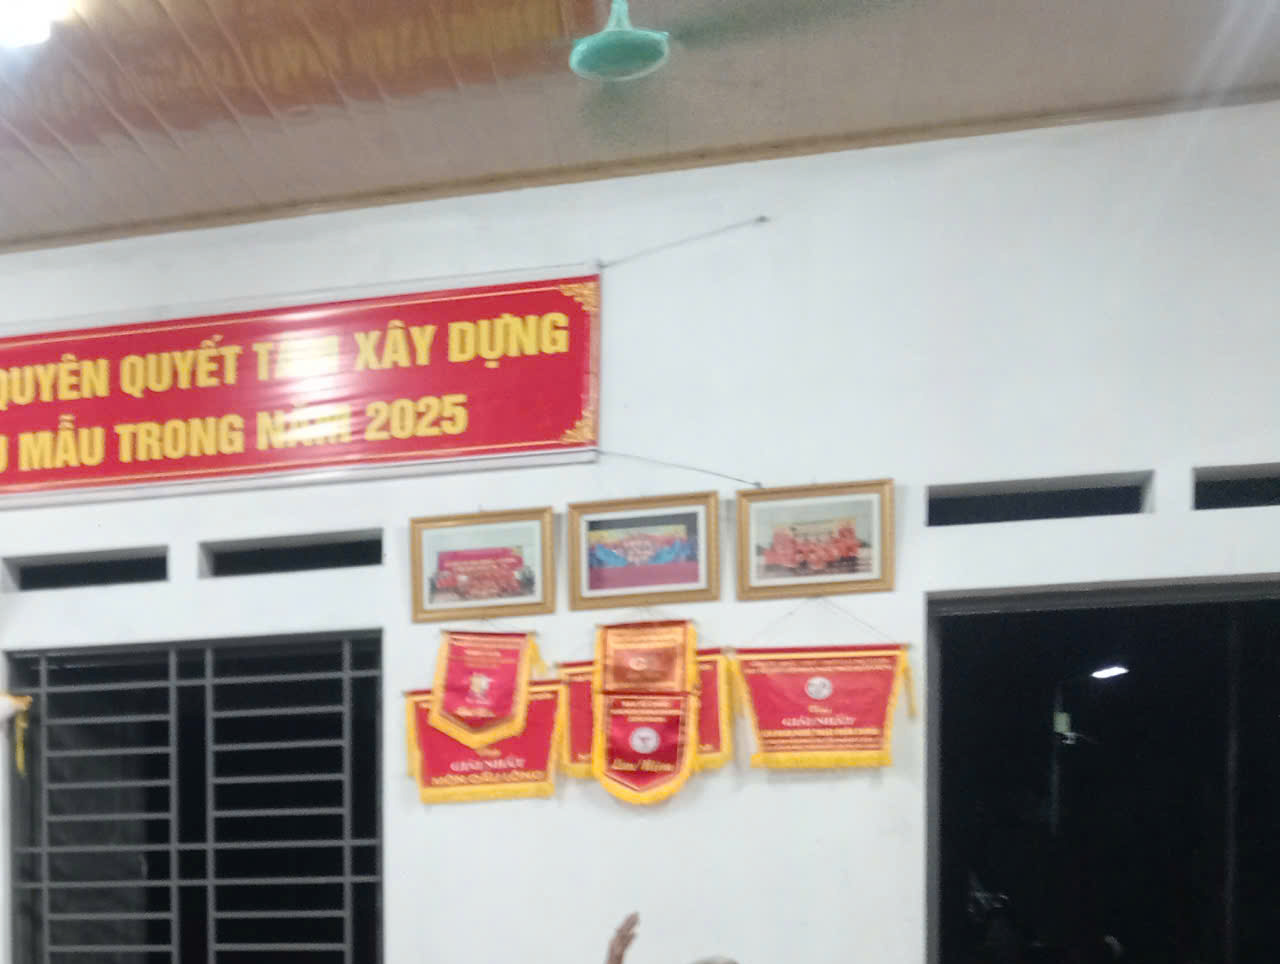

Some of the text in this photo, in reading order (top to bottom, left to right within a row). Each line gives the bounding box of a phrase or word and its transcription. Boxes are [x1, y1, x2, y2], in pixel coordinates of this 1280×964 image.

[120, 334, 242, 398] QUYẾT
[354, 319, 437, 371] XÂY
[448, 311, 570, 368] DỰNG
[18, 413, 106, 472] MẪU
[114, 413, 245, 464] TRONG
[364, 394, 469, 442] 2025
